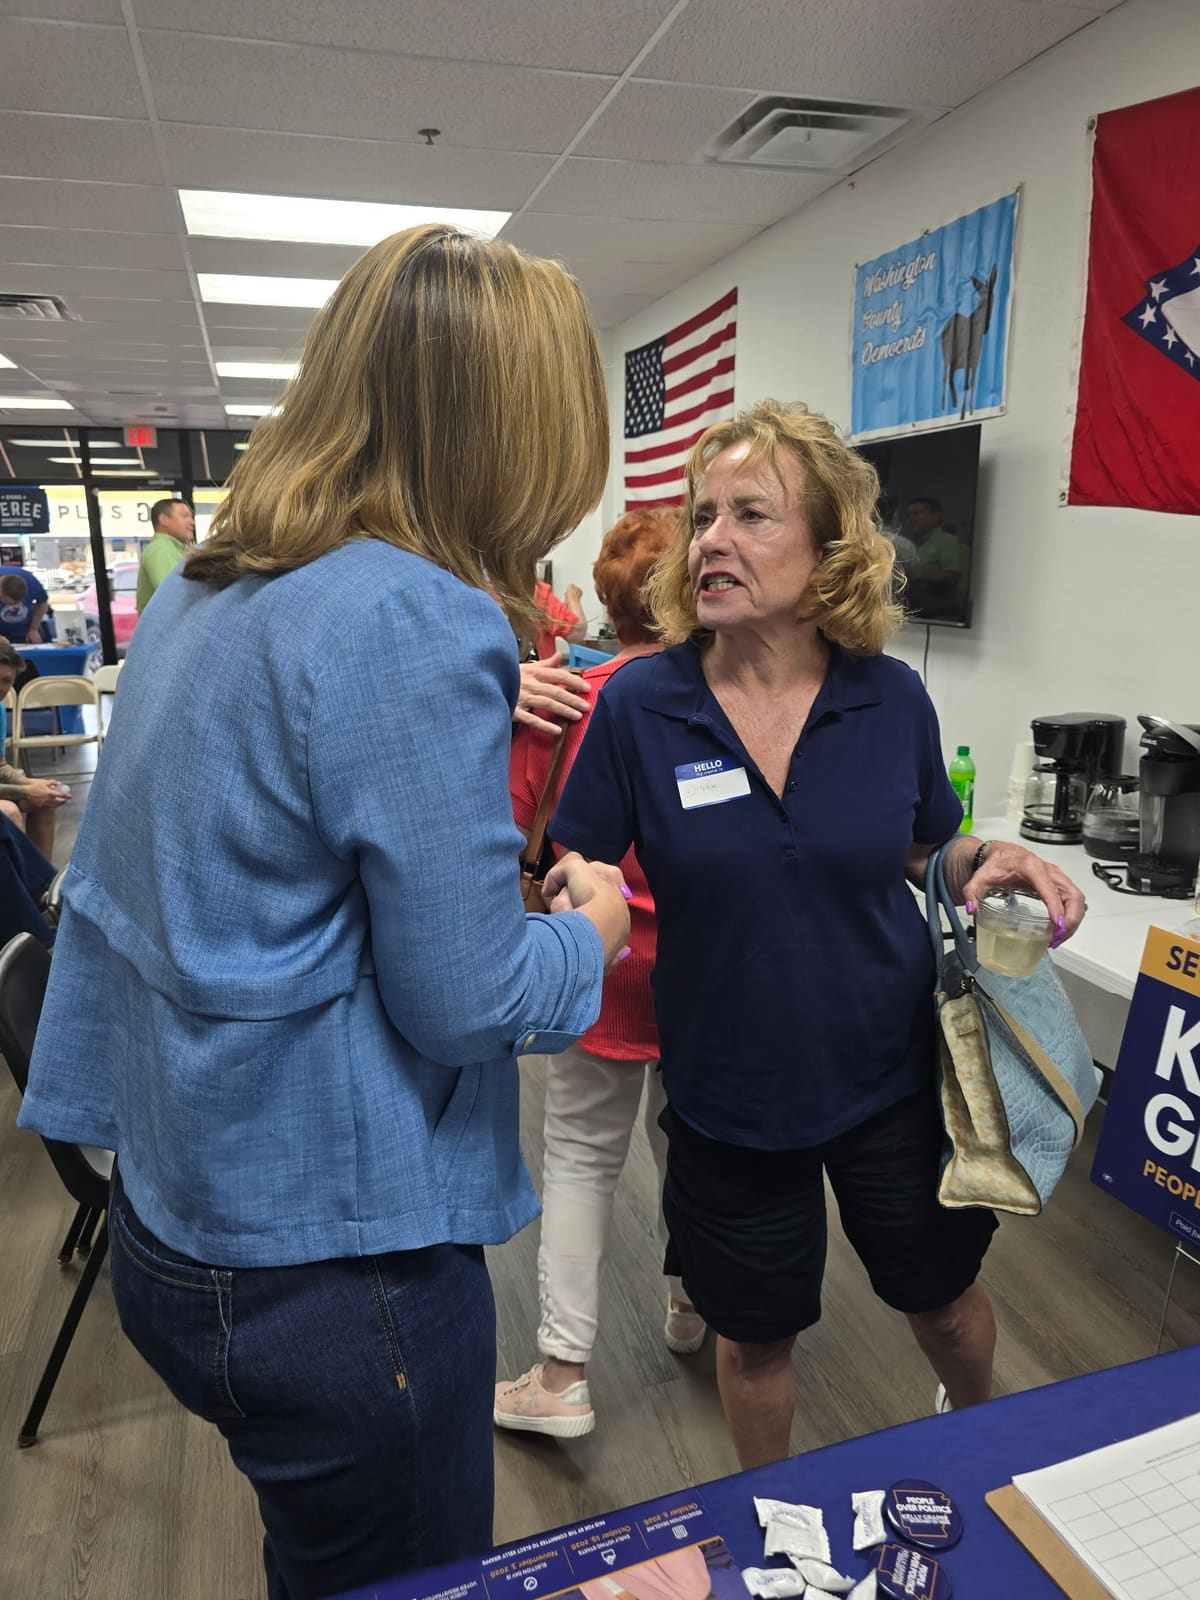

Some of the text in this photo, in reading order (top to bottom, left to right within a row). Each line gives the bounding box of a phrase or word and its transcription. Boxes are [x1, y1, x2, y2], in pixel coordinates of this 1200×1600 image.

[864, 253, 936, 296] Washington
[862, 301, 903, 334] County
[862, 326, 926, 366] Democrats
[58, 504, 122, 519] PLS
[694, 760, 722, 772] HELLO
[1144, 1093, 1200, 1171] G
[1175, 1219, 1192, 1233] Paid
[906, 1496, 935, 1504] PEOPLE
[918, 1505, 952, 1514] POLITICS
[602, 1525, 631, 1539] October
[517, 1544, 532, 1554] ELECT
[519, 1551, 558, 1567] November
[522, 1562, 547, 1574] ELECTION
